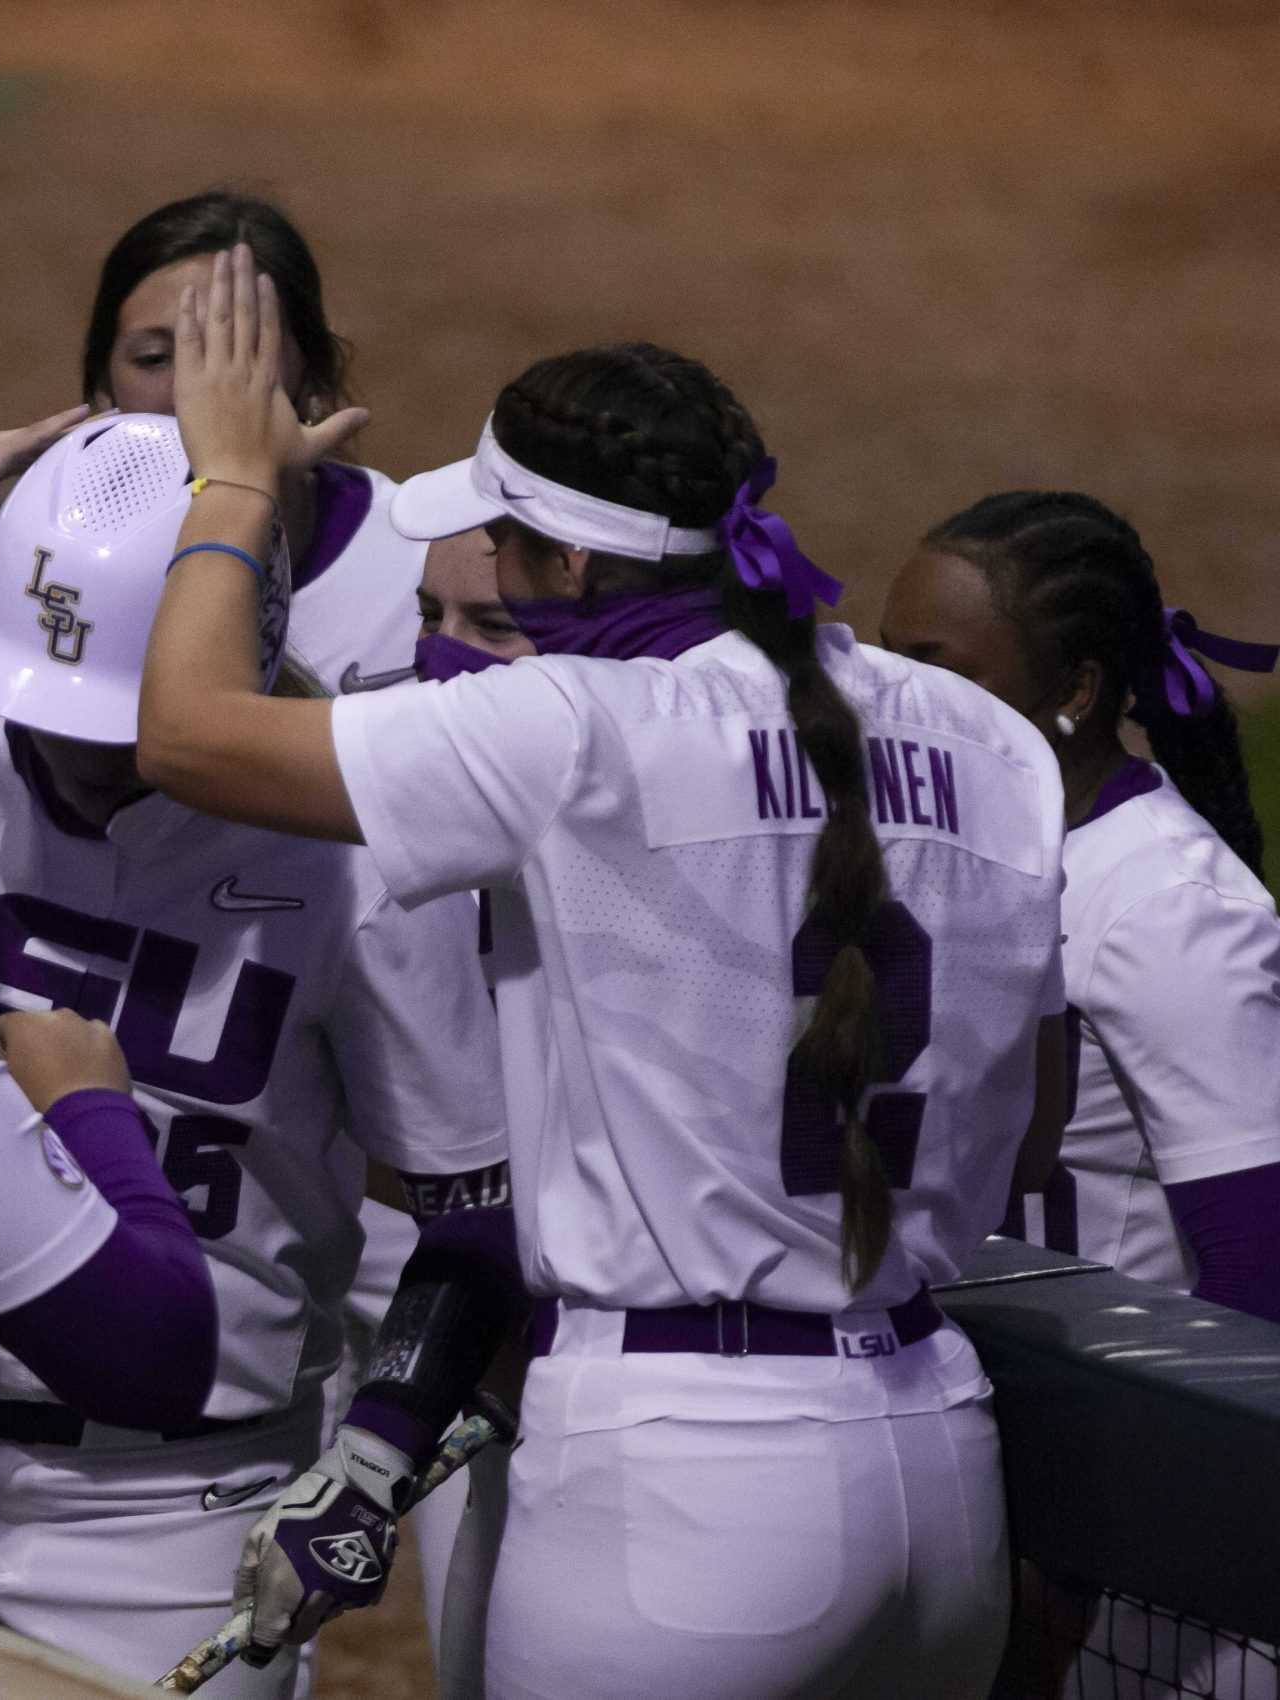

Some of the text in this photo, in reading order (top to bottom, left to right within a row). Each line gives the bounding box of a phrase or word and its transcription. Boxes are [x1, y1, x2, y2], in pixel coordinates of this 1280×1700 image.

[24, 544, 95, 667] LSU
[748, 729, 959, 835] KILNEN
[840, 1333, 896, 1359] LSU
